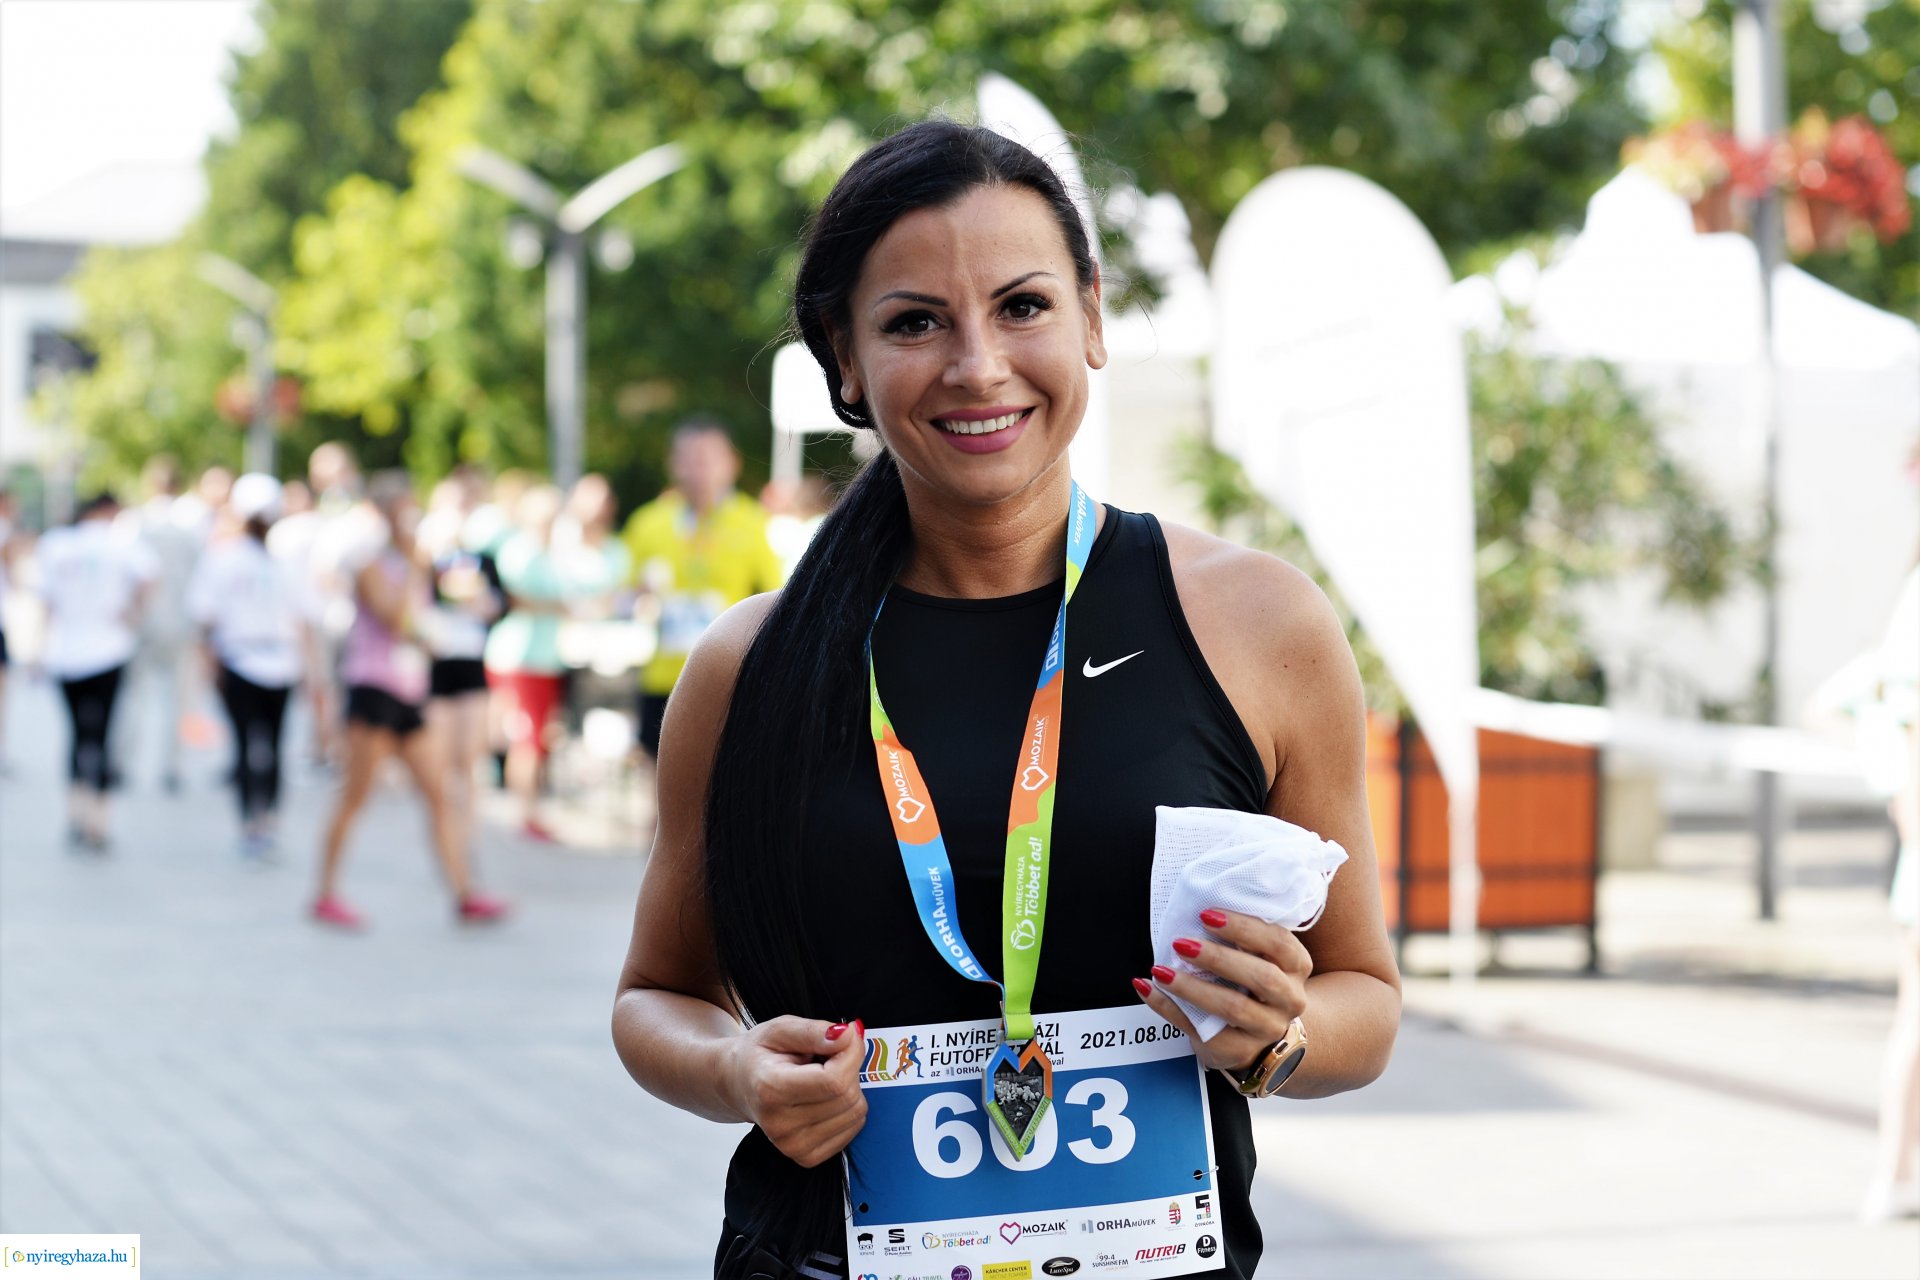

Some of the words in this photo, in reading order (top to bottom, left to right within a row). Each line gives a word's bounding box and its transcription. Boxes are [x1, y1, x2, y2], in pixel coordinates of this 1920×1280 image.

[1030, 718, 1046, 766] MOZAIK
[888, 751, 909, 797] MOZAIK
[1028, 836, 1043, 862] ad!
[1015, 856, 1026, 916] NYÍREGYHÁZA
[1025, 864, 1042, 917] Többet
[931, 1034, 940, 1049] I.
[946, 1023, 1060, 1047] NYÍREÁZI
[1080, 1023, 1185, 1050] 2021.08.08.
[912, 1077, 1136, 1179] 603
[943, 1238, 974, 1248] Többet
[977, 1235, 991, 1244] ad!
[1022, 1222, 1066, 1234] MOZAIK
[1203, 1236, 1210, 1247] D
